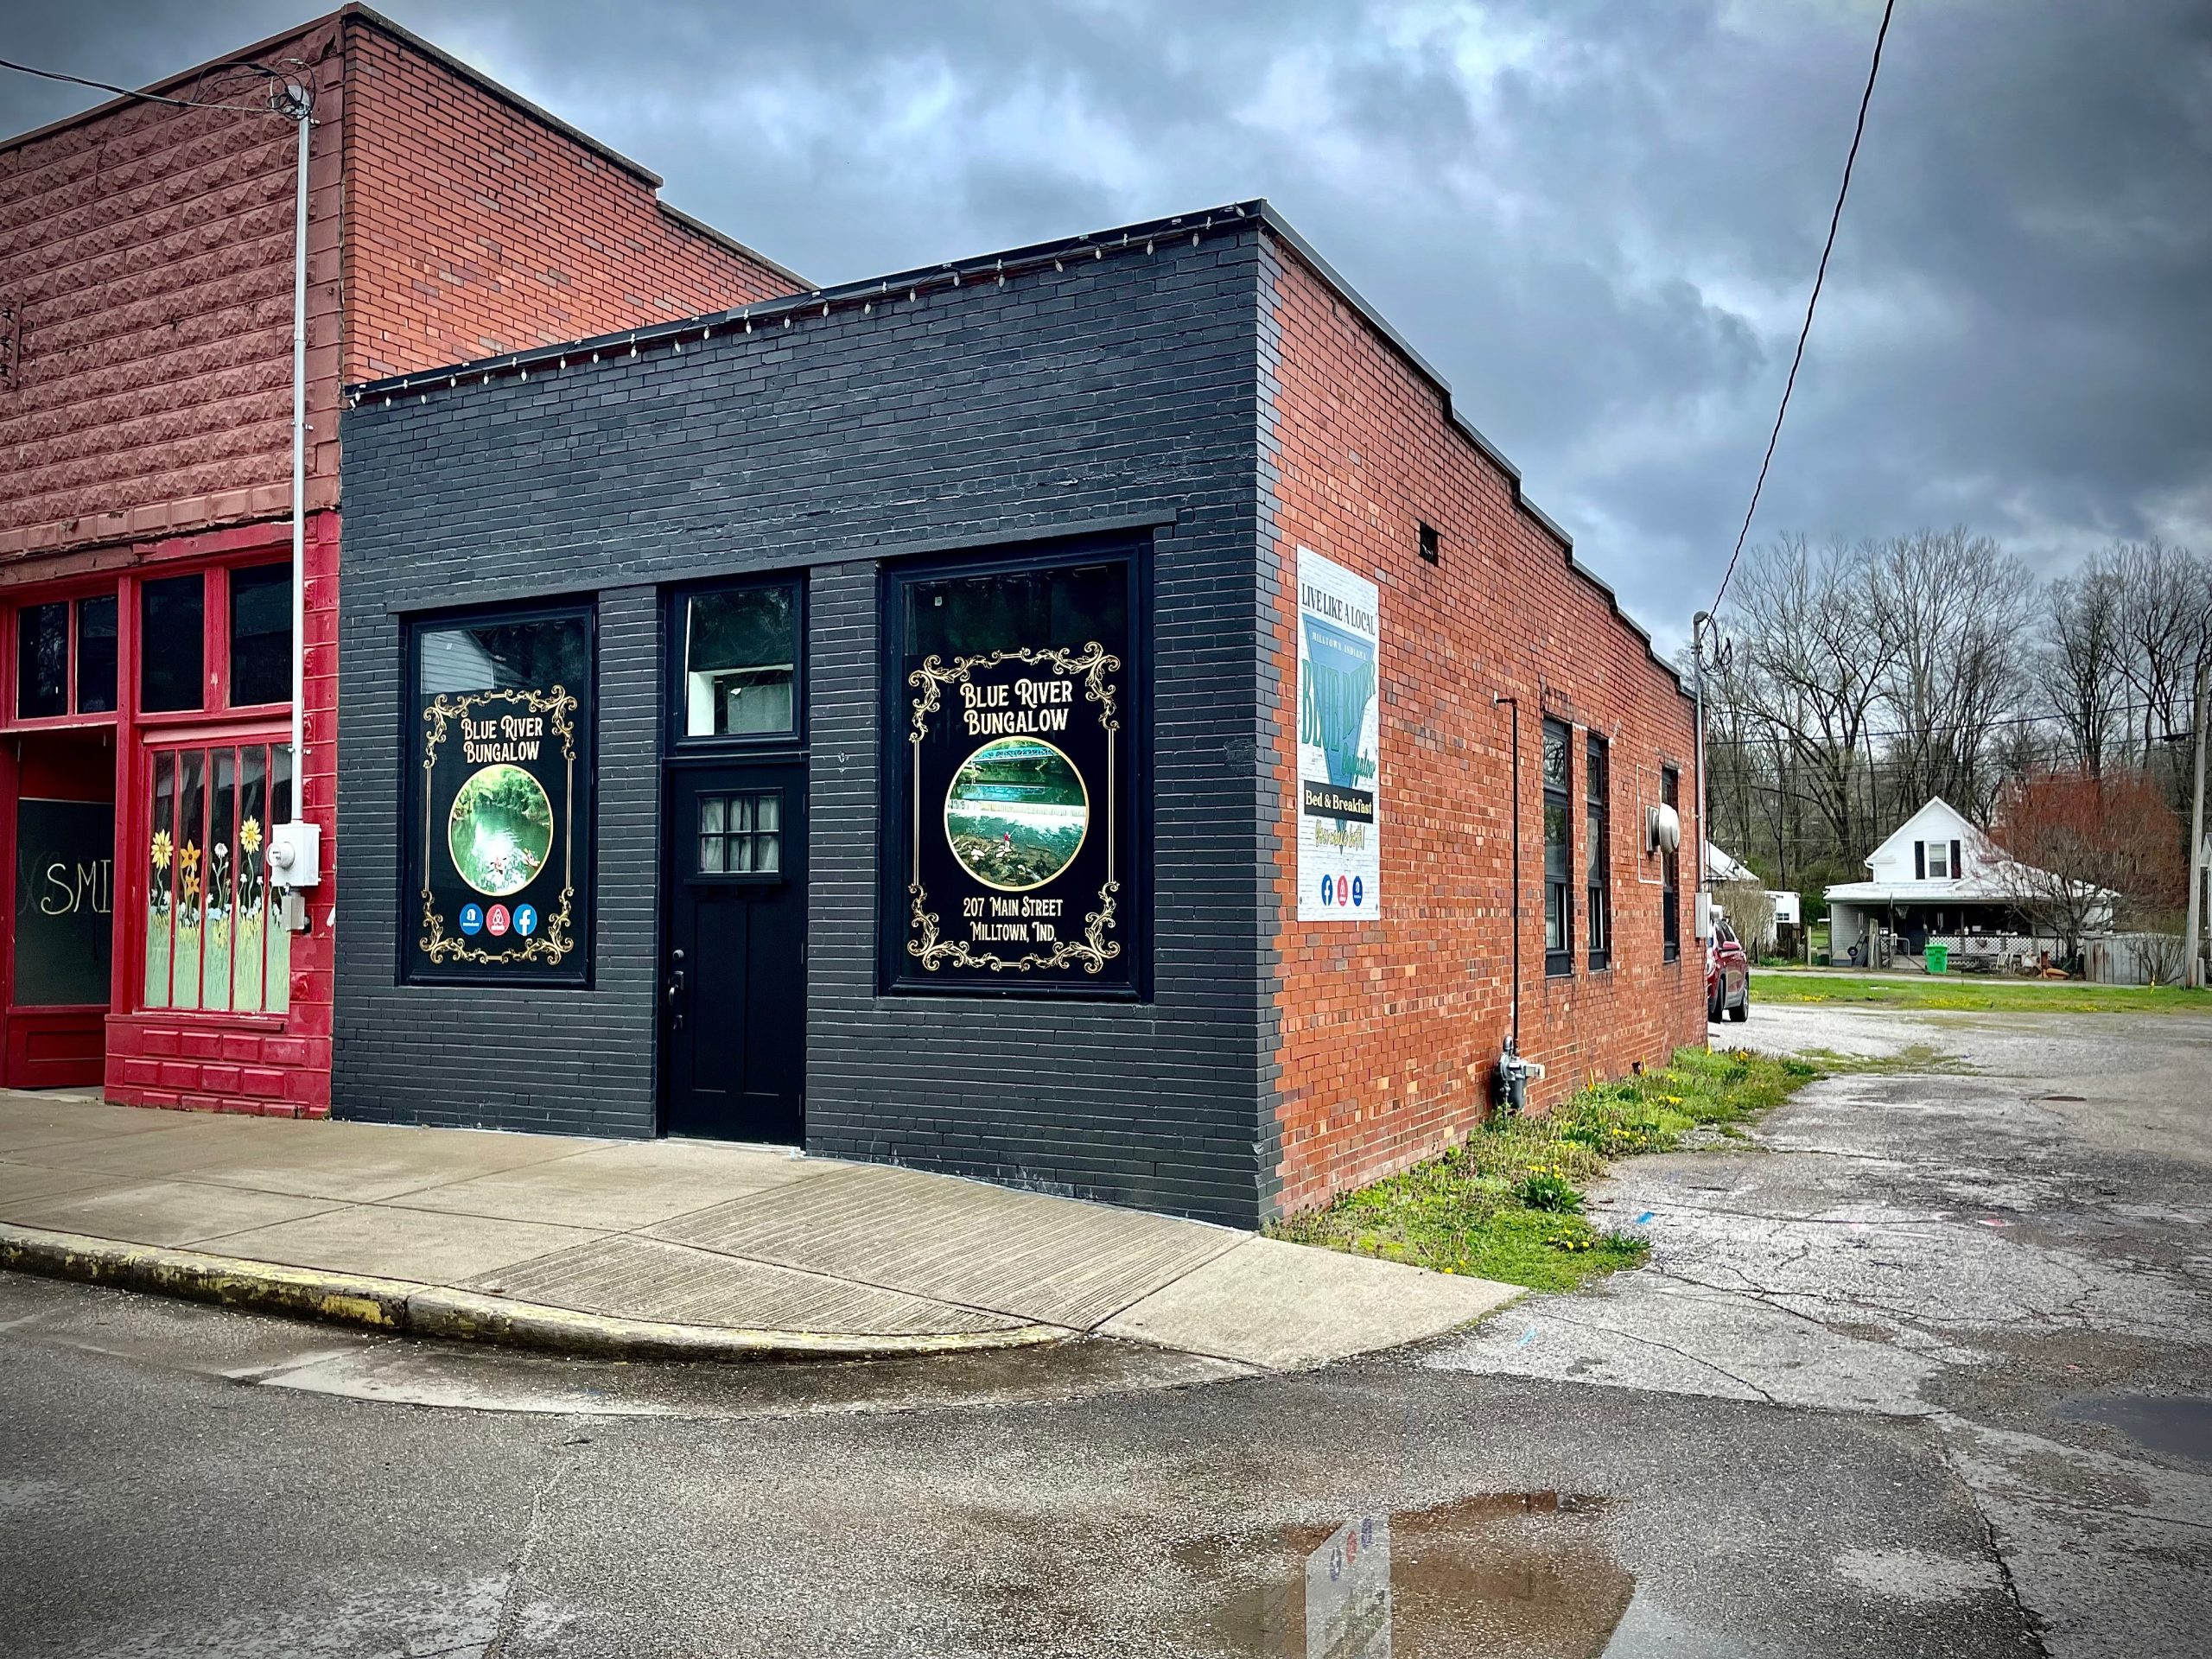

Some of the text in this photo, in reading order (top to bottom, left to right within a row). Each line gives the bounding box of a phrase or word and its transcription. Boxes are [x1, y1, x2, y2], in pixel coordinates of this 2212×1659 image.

[1301, 582, 1376, 636] LIVE LIKE A LOCAL
[959, 678, 1072, 709] BLUE RIVER
[1301, 658, 1376, 752] BLUE RIVER
[461, 715, 543, 741] BLUE RIVER
[963, 708, 1069, 735] BUNGALOW
[463, 741, 540, 764] BUNGALOW
[1305, 789, 1373, 815] Bed & Breakfast
[963, 896, 1063, 918] 207 MAIN STREET
[969, 920, 1058, 943] MILLTOWN, IND.
